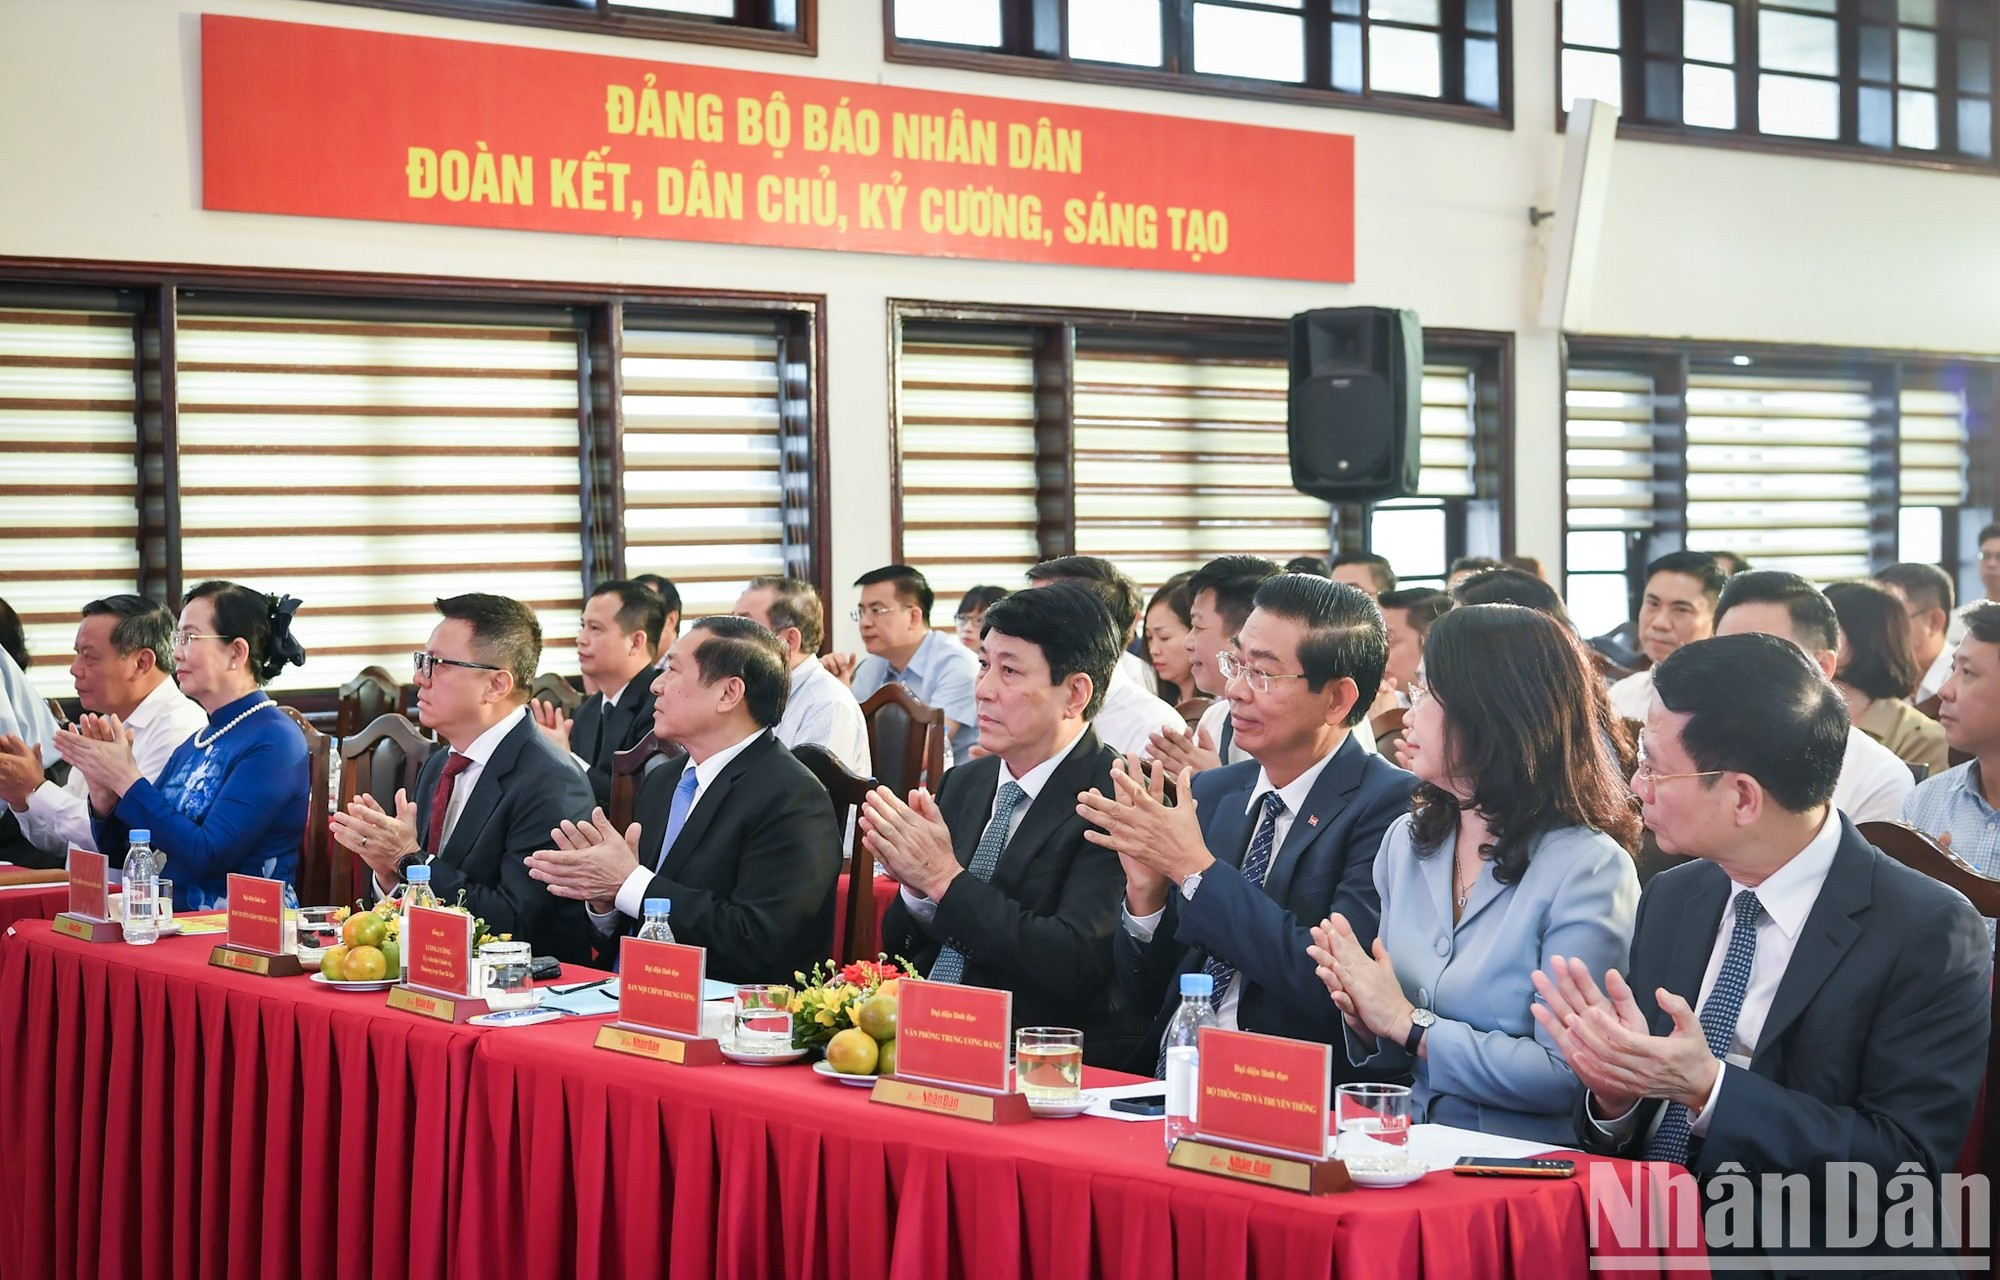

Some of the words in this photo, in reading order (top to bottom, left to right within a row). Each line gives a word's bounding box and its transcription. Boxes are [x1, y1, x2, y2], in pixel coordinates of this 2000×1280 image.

[605, 72, 724, 143] ĐẢNG
[737, 91, 791, 158] BỘ
[804, 97, 880, 156] BÁO
[892, 108, 997, 167] NHÂN
[1009, 117, 1082, 174] DÂN
[406, 140, 534, 206] ĐOÀN
[550, 146, 643, 219] KẾT,
[657, 159, 743, 220] DÂN
[757, 165, 847, 233] CHỦ,
[859, 170, 908, 231] KỶ
[920, 184, 1053, 247] CƯƠNG,
[1063, 191, 1158, 249] SÁNG
[1166, 207, 1228, 262] TẠO
[628, 983, 637, 991] BAN
[663, 990, 680, 999] TRUNG
[931, 1008, 940, 1018] Đại
[941, 1010, 953, 1019] diện
[953, 1012, 965, 1020] lãnh
[966, 1013, 976, 1022] đạo
[918, 1030, 940, 1041] PHÒNG
[941, 1034, 963, 1044] TRUNG
[964, 1036, 983, 1047] ƯƠNG
[984, 1038, 1002, 1050] ĐẢNG
[1234, 1064, 1245, 1075] Đại
[1246, 1066, 1260, 1078] diện
[1261, 1068, 1275, 1079] lãnh
[1276, 1071, 1288, 1082] đạo
[1206, 1086, 1216, 1097] BỘ
[1217, 1088, 1241, 1100] THÔNG
[1241, 1093, 1252, 1102] TIN
[1252, 1094, 1263, 1105] VÀ
[1291, 1101, 1317, 1114] THÔNG
[1228, 1155, 1252, 1171] Nhân
[1254, 1159, 1272, 1175] Dân
